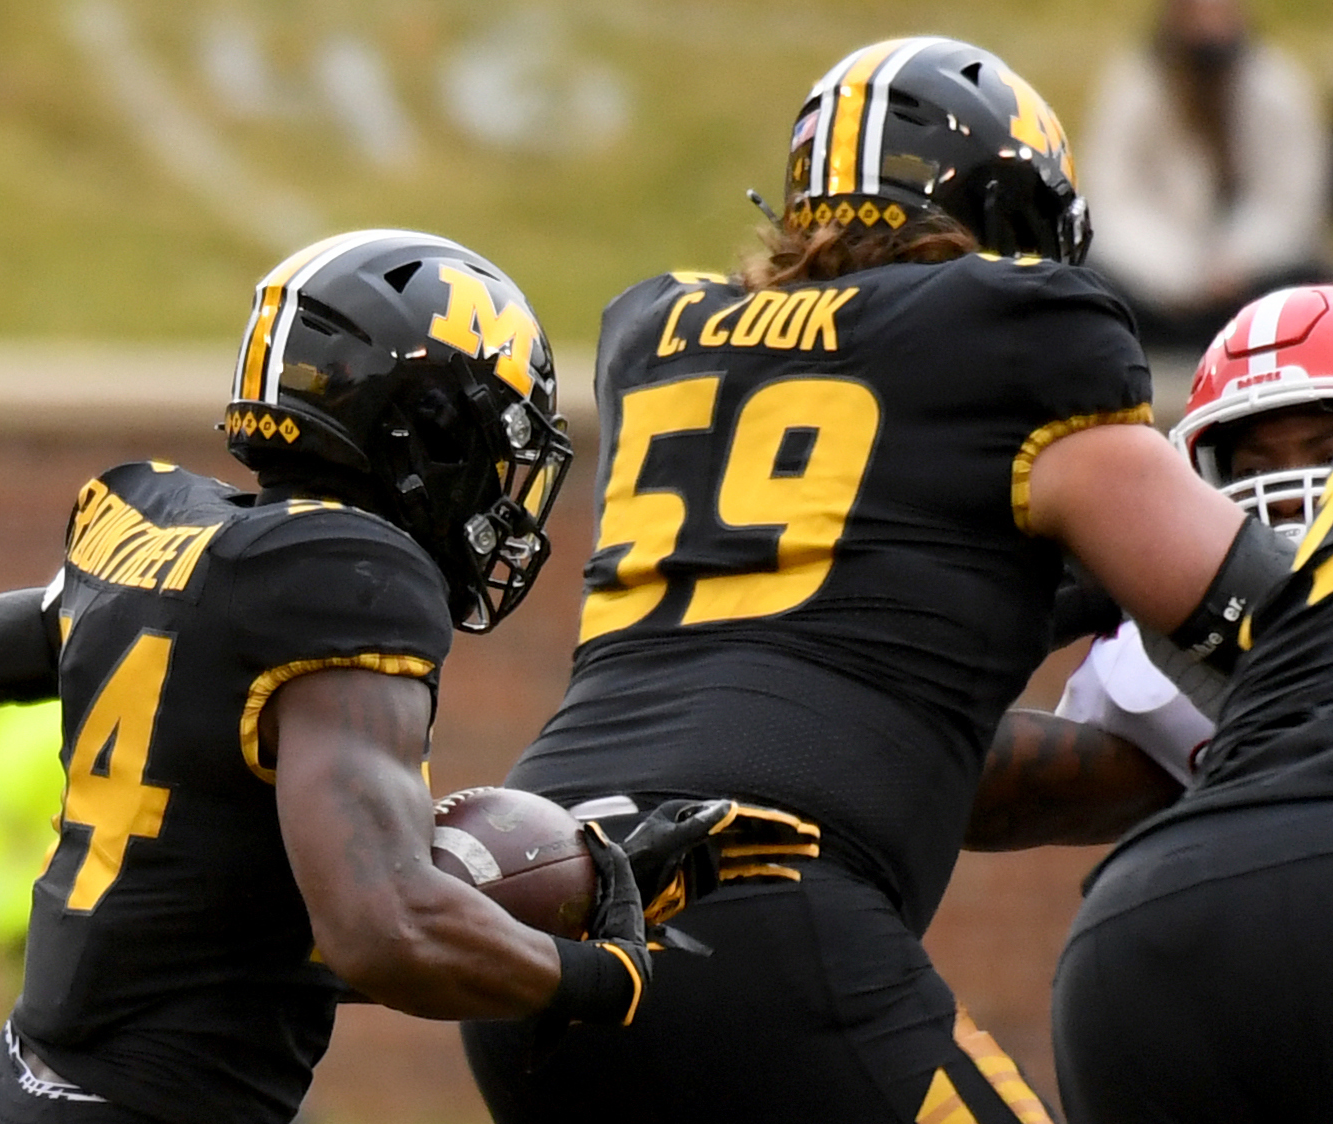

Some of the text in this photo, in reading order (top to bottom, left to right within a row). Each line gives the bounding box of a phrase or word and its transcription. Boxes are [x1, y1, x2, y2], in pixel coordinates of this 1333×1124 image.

[428, 264, 540, 401] M
[699, 287, 860, 351] COOK
[579, 375, 881, 646] 59
[45, 614, 174, 911] 4
